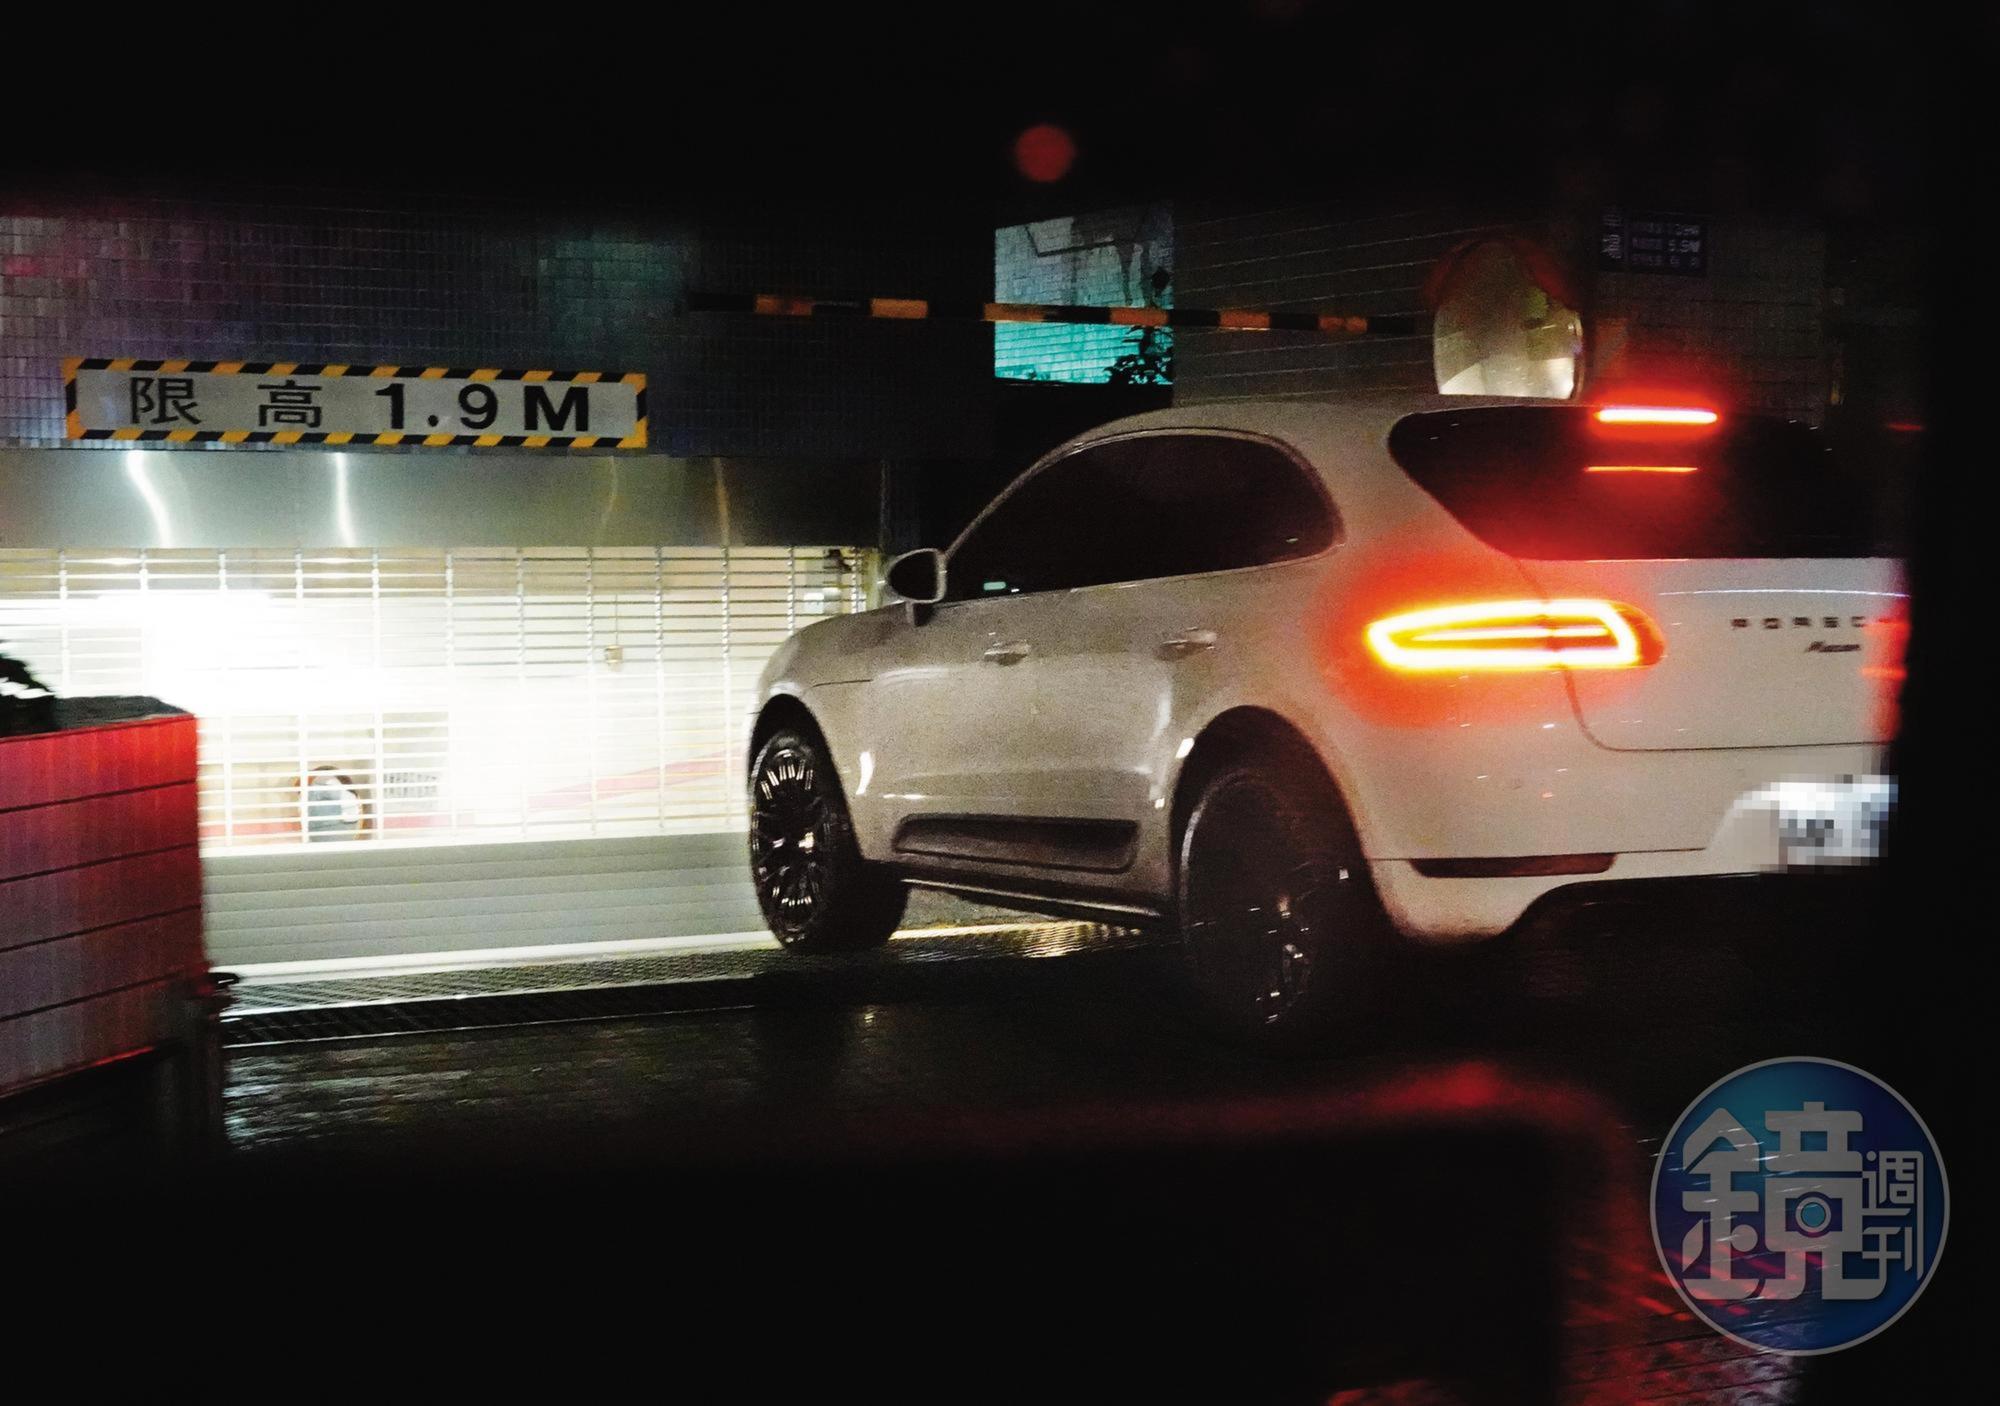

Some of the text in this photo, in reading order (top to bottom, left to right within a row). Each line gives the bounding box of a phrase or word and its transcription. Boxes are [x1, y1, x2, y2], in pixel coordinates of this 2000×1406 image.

[129, 376, 590, 432] 限高 1.9M
[1731, 616, 1868, 629] PORSC
